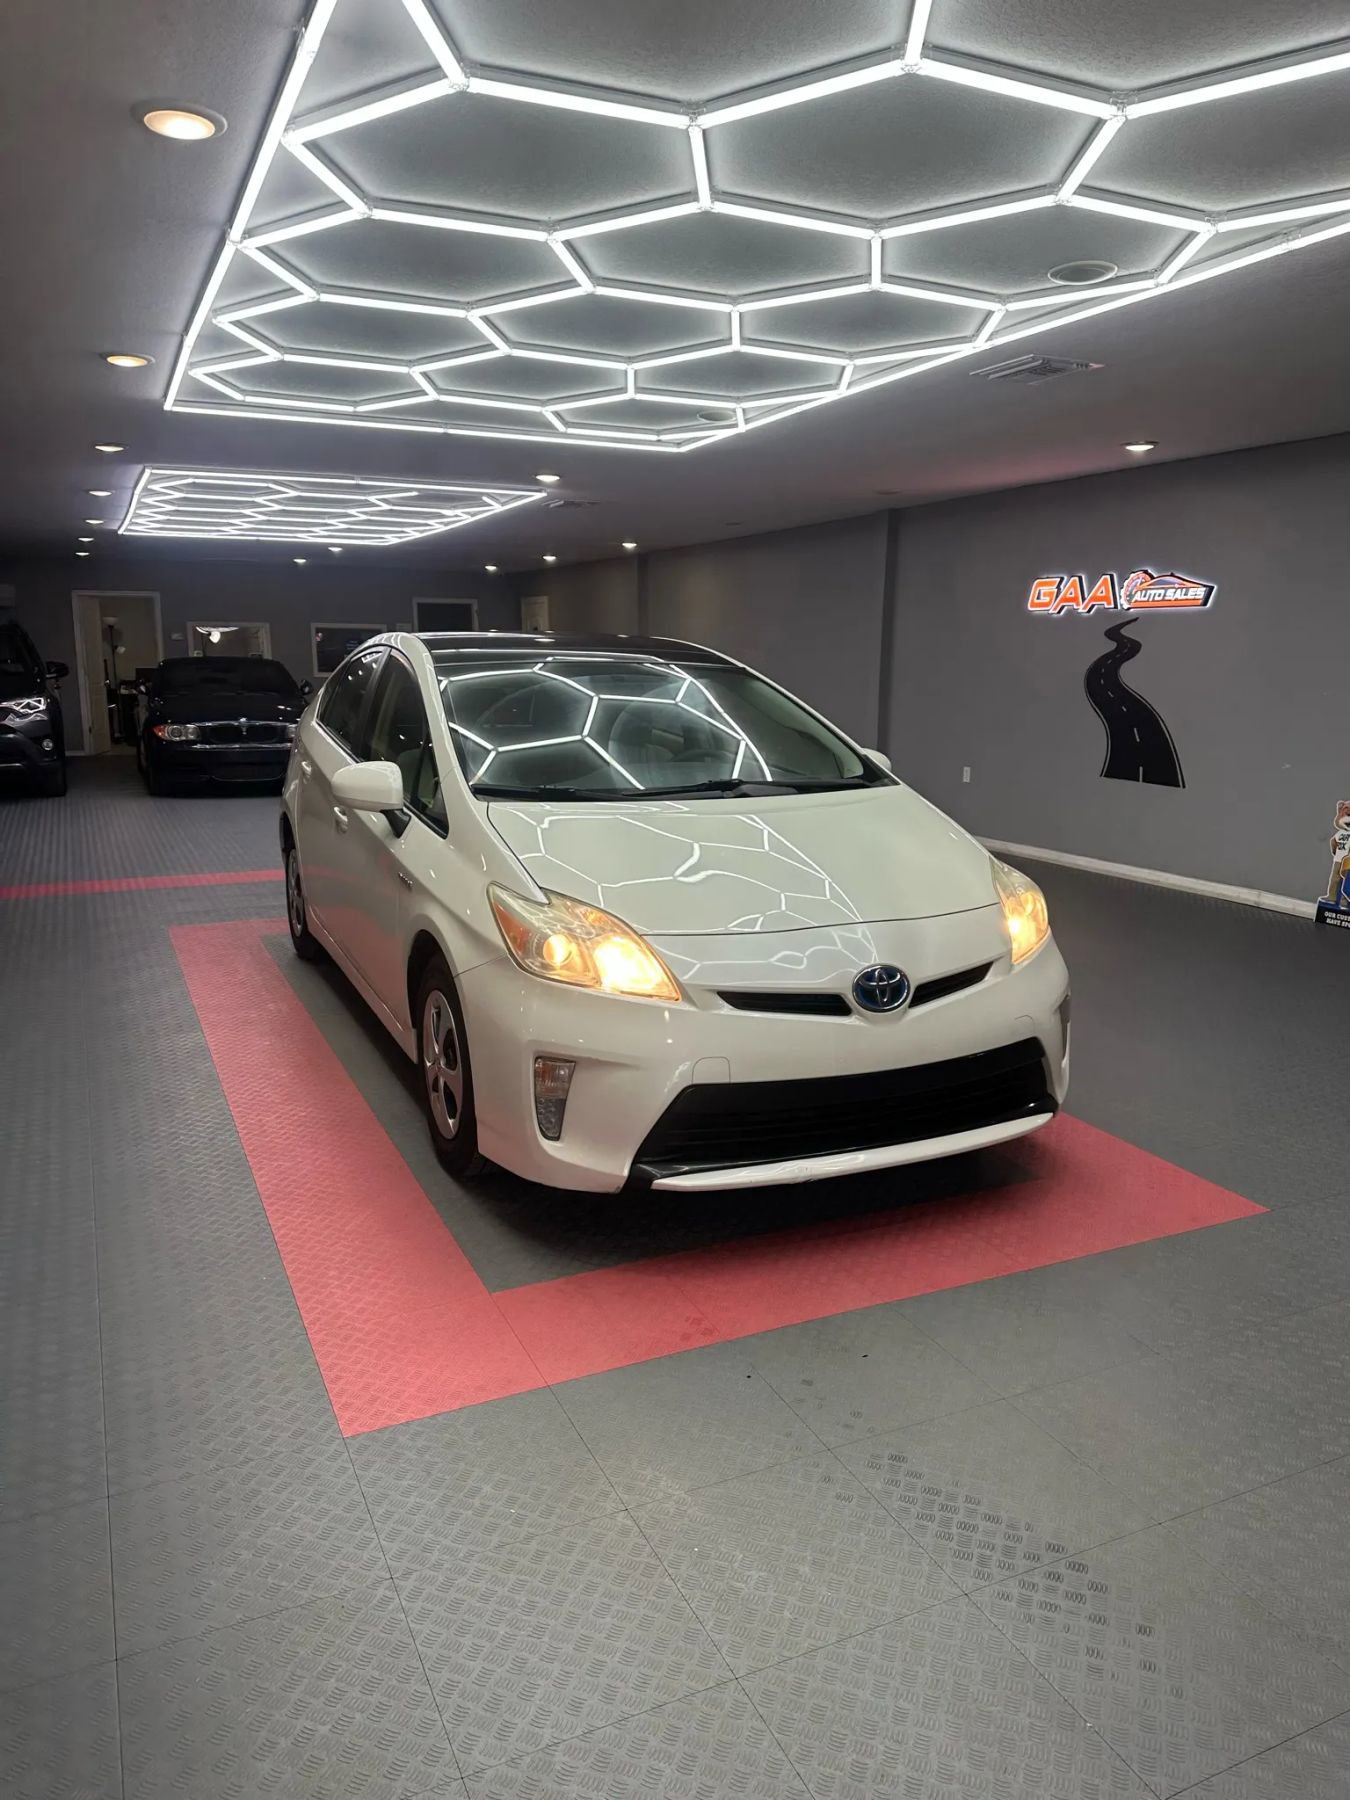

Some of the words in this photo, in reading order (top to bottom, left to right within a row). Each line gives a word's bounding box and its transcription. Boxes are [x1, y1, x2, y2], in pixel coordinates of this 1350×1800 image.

[1028, 574, 1117, 613] GAA
[1133, 590, 1164, 603] AUTO
[1164, 588, 1206, 602] SALES
